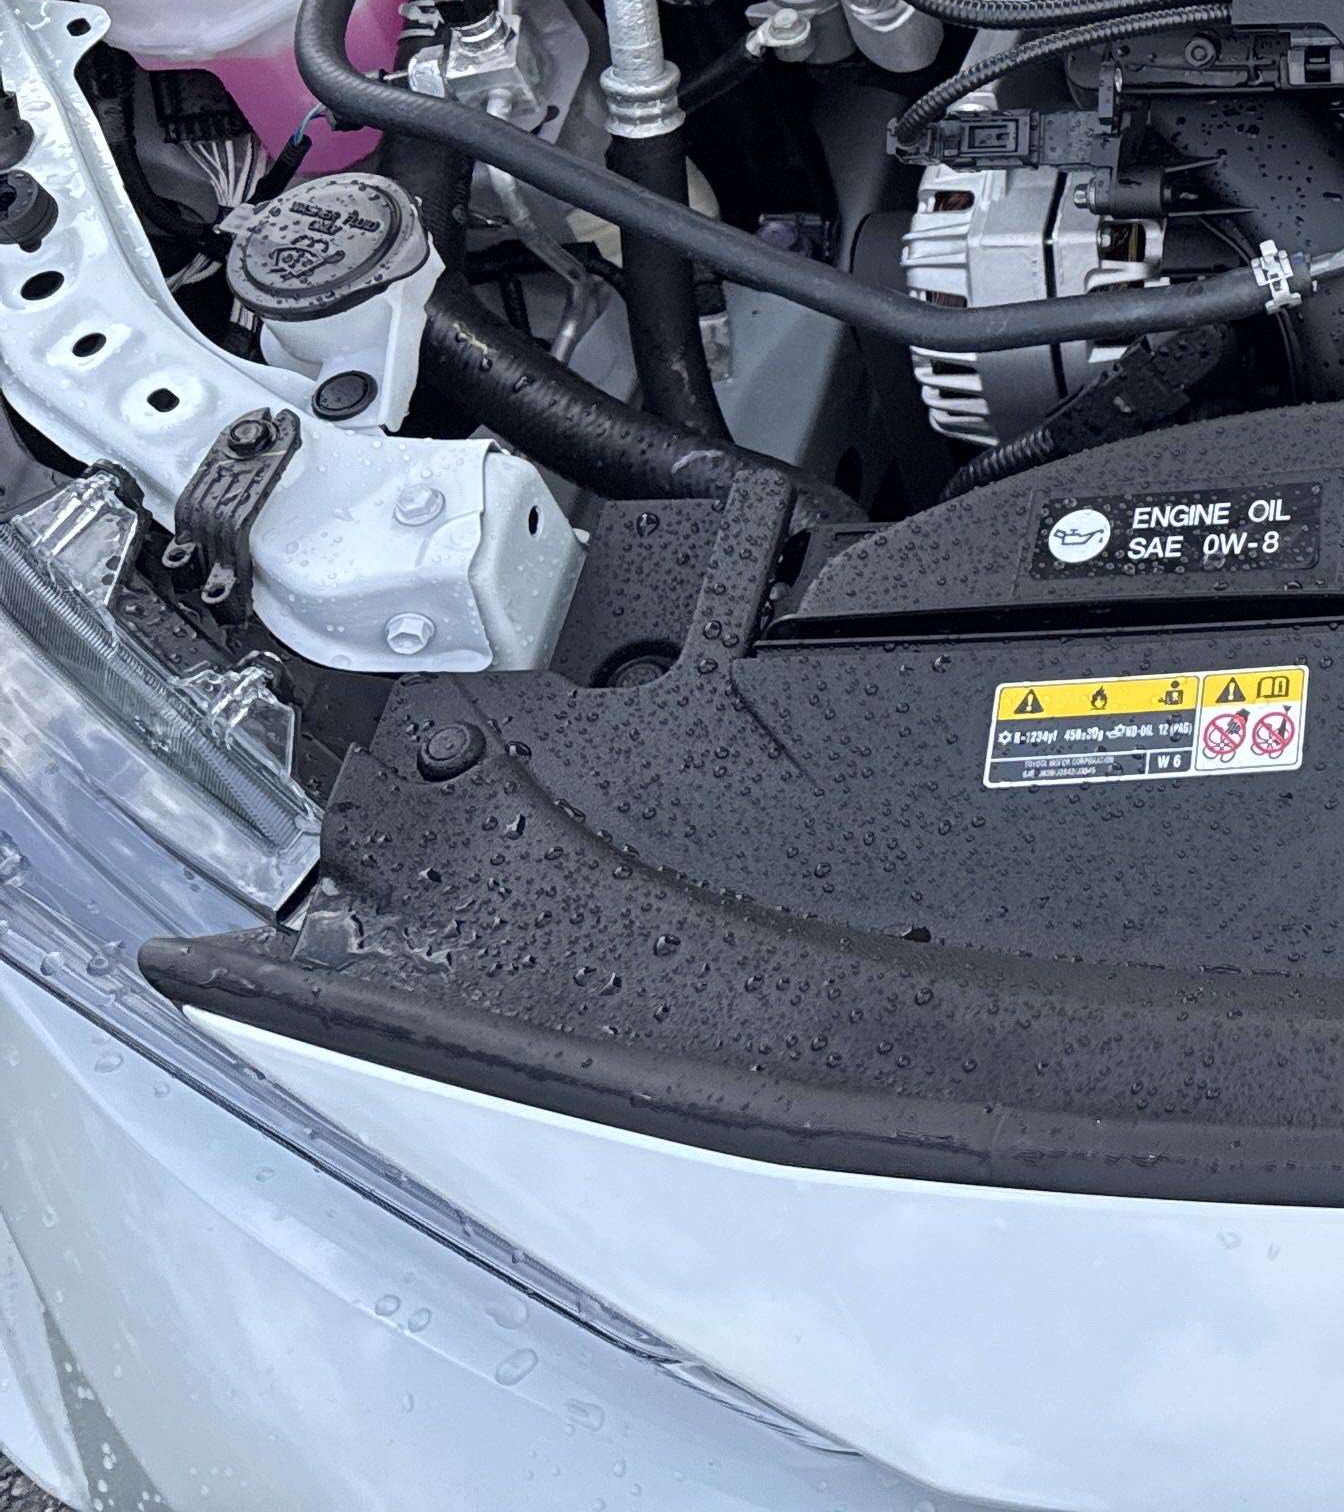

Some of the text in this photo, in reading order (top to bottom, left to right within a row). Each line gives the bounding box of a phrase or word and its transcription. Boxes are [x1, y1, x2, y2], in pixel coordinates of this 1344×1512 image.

[1132, 499, 1291, 530] ENGINE OIL
[1127, 531, 1280, 560] SAE 0W-8
[1014, 729, 1058, 744] R-1234yf
[1157, 754, 1182, 768] W 6
